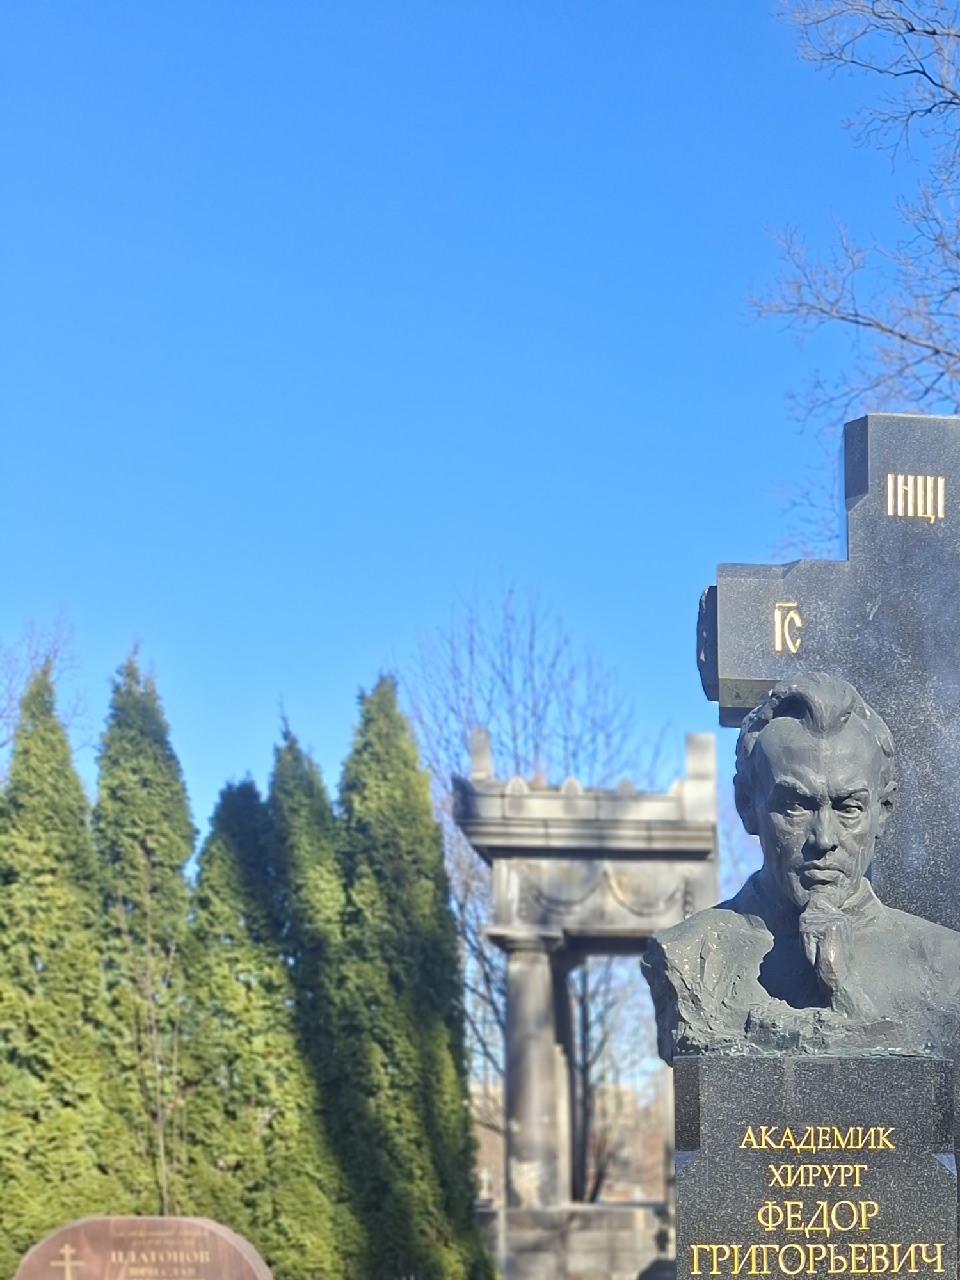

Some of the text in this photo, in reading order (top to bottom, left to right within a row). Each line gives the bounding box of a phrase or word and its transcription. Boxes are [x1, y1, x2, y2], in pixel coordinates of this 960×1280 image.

[739, 1125, 896, 1153] АКАДЕМИК
[768, 1164, 868, 1188] ХИРУРГ
[756, 1200, 879, 1238] ФЕДОР
[690, 1243, 945, 1275] ГРИГОРЬЕВИЧ
